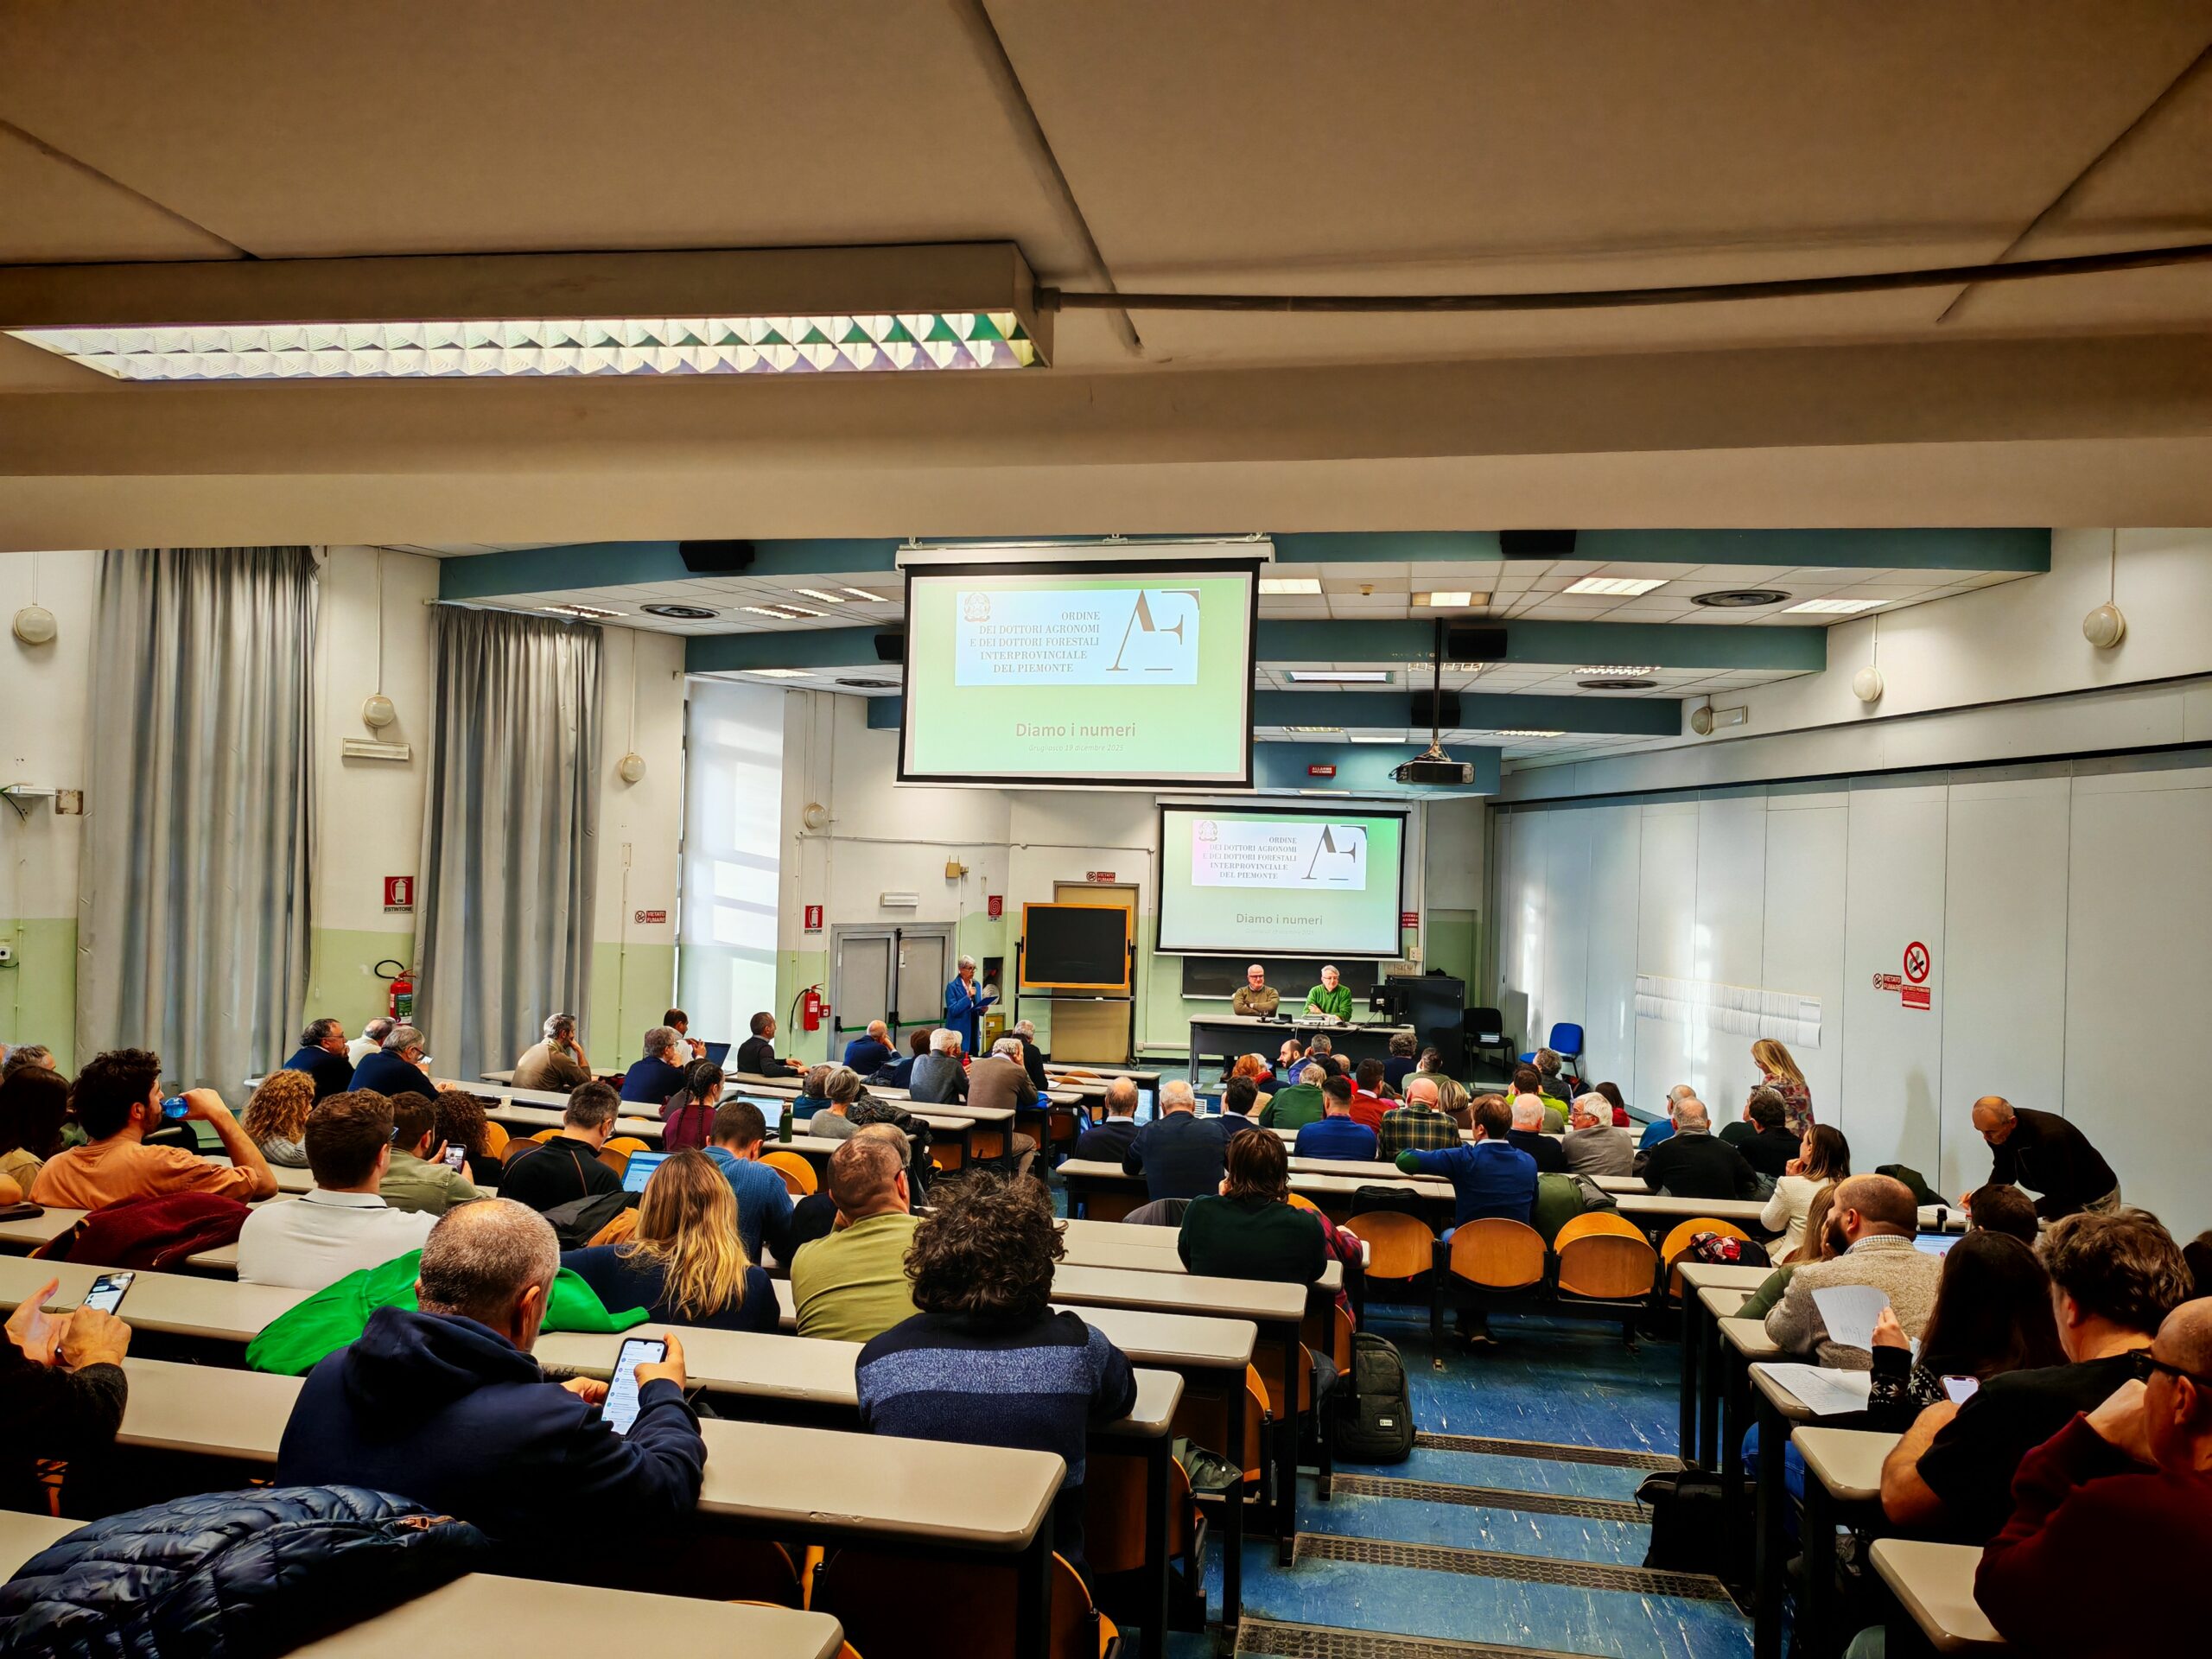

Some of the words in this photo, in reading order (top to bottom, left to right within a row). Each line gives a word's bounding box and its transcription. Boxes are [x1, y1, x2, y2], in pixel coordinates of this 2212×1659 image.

[1061, 612, 1100, 620] ORDINE
[979, 626, 996, 634] DEI
[999, 625, 1043, 634] DOTTORI
[1045, 624, 1100, 633] AGRONOMI
[969, 638, 976, 647] E
[979, 638, 996, 647] DEI
[999, 638, 1042, 647] DOTTORI
[1046, 637, 1099, 646] FORESTALI
[981, 651, 1087, 660] INTERPROVINCIALE
[994, 664, 1014, 673] DEL
[1018, 664, 1073, 673] PIEMONTE
[1015, 723, 1066, 737] Diamo
[1071, 722, 1076, 737] i
[1080, 722, 1136, 737] numeri
[1210, 861, 1288, 870] INTERPROVINCIALE
[1236, 913, 1273, 924] Diamo
[1276, 914, 1280, 925] i
[1282, 915, 1323, 925] numeri
